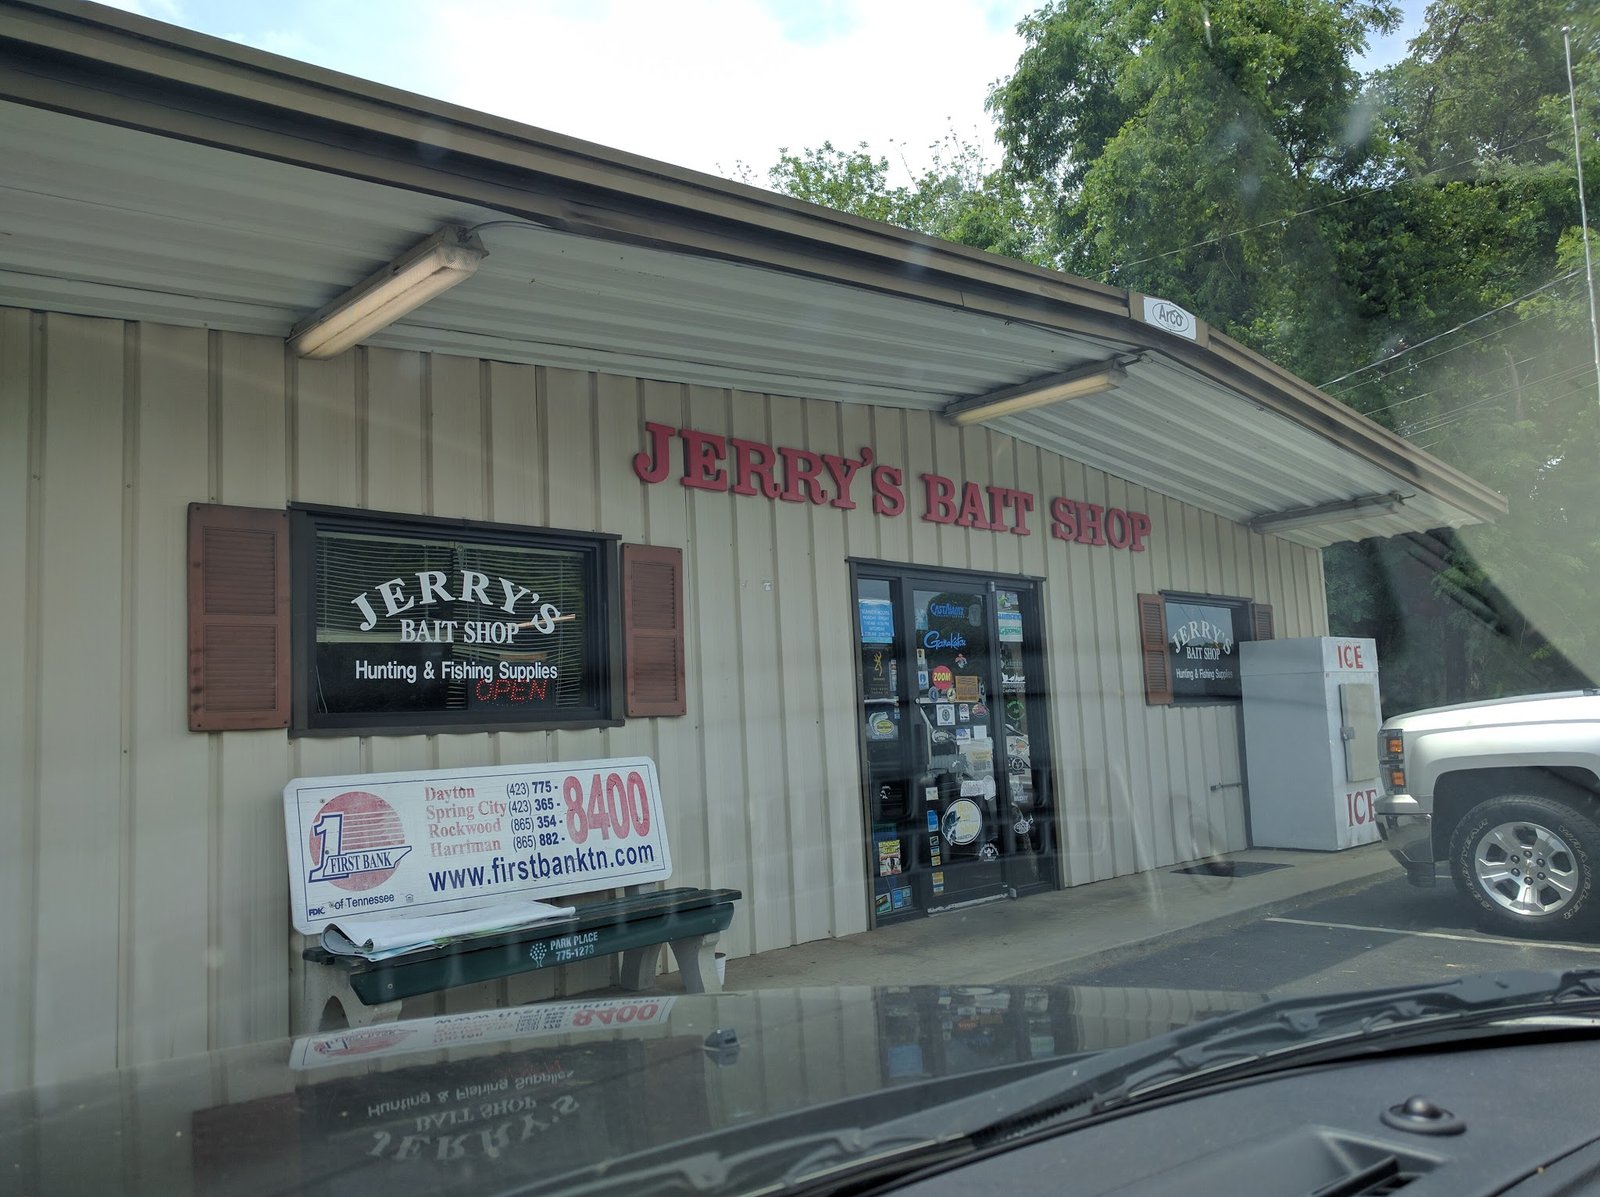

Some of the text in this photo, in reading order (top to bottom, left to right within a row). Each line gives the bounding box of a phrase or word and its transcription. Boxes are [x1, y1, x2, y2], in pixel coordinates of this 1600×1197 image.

[1158, 305, 1184, 327] Arco
[633, 421, 1152, 552] JERRY'S BAIT SHOP
[351, 570, 561, 634] JERRY'S
[400, 619, 520, 644] BAIT SHOP
[1172, 620, 1232, 655] JERRY'S
[1185, 646, 1221, 660] BAIT SHOP
[1337, 645, 1364, 669] ICE
[355, 660, 558, 683] Hunting & Fishing Supplies
[1176, 668, 1195, 680] Hunting
[1199, 668, 1215, 681] Fishing
[1215, 668, 1234, 680] Supplies
[476, 678, 548, 702] OPEN
[424, 785, 475, 803] Dayton
[506, 782, 530, 799] (423)
[425, 803, 475, 823] Spring
[478, 800, 507, 818] City
[508, 799, 532, 816] (423)
[562, 771, 651, 845] 8400
[428, 818, 502, 838] Rockwood
[511, 816, 535, 834] (865)
[430, 840, 502, 858] Harriman
[513, 835, 537, 852] (865)
[330, 851, 392, 874] FIRST BANK
[428, 844, 655, 892] www.firstbanktn.com
[308, 907, 326, 917] FDIC
[334, 893, 395, 910] of Tennessee
[550, 931, 599, 951] PARK PLACE
[555, 944, 595, 962] 775-1273
